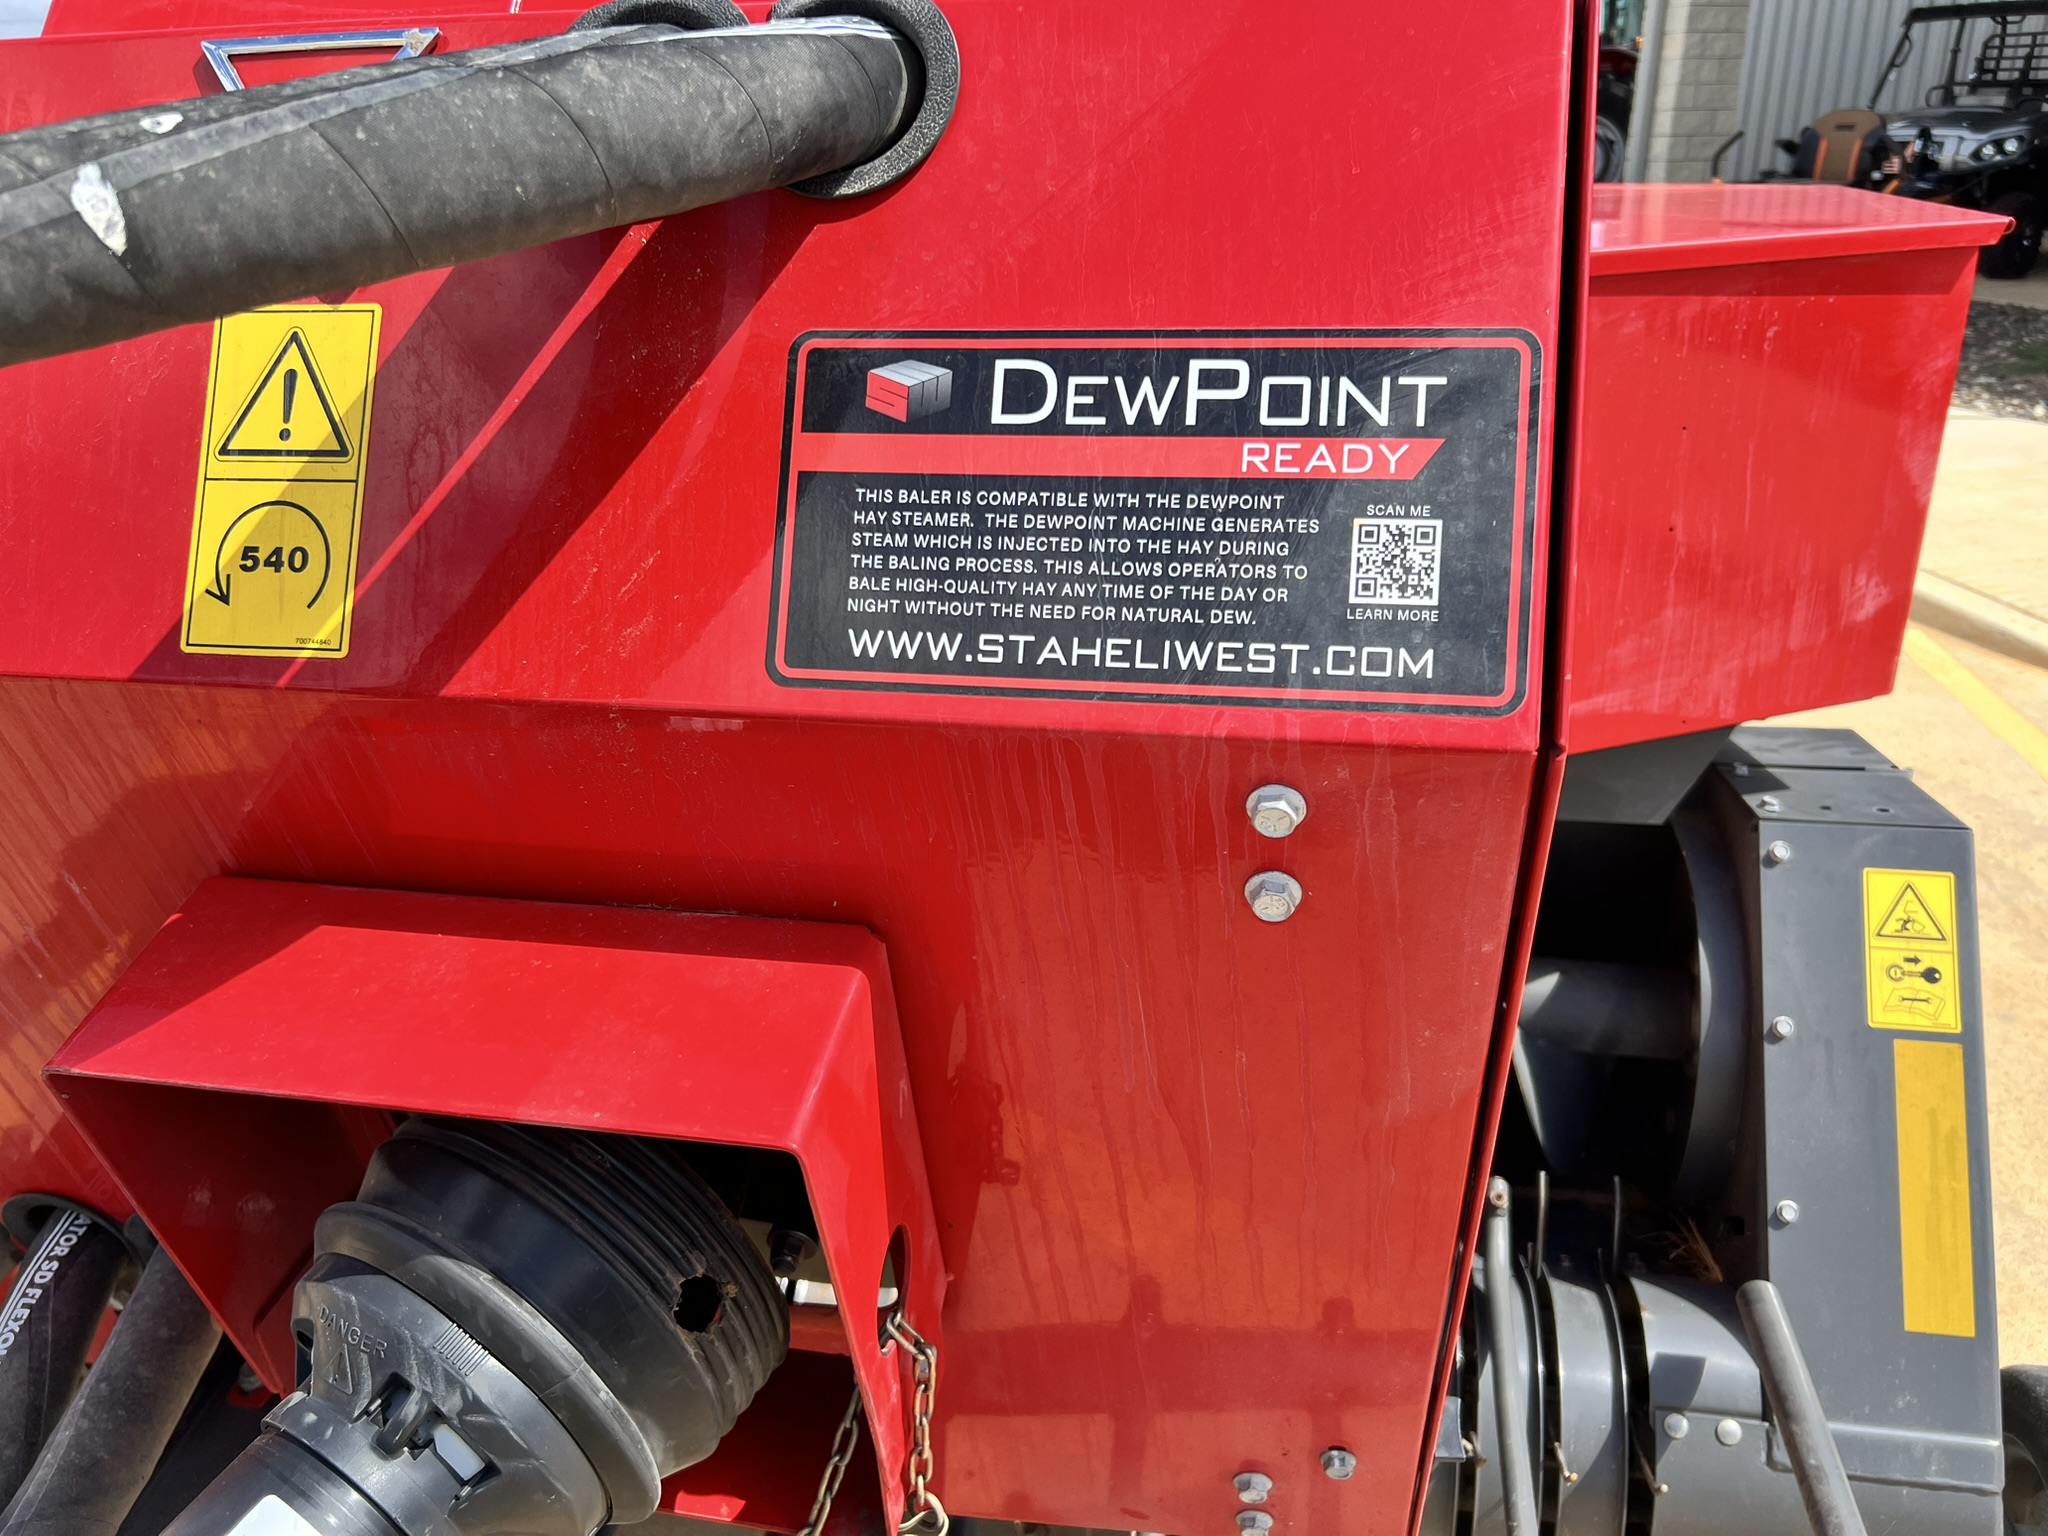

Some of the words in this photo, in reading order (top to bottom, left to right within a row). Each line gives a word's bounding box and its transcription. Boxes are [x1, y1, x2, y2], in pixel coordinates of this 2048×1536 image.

[1241, 442, 1410, 474] READY
[855, 488, 893, 503] THIS
[898, 489, 952, 505] BALER
[956, 490, 972, 505] IS
[976, 490, 1088, 507] COMPATIBLE
[1093, 493, 1140, 508] WITH
[1145, 493, 1181, 509] THE
[1186, 494, 1285, 510] DEWPOINT
[1366, 504, 1405, 517] SCAN
[1409, 504, 1431, 517] ME
[853, 510, 888, 525] HAY
[891, 511, 974, 527] STEAMER.
[984, 513, 1018, 529] THE
[1023, 514, 1118, 530] DEWPOINT
[1122, 516, 1206, 532] MACHINE
[1211, 517, 1320, 534] GENERATES
[851, 532, 908, 548] STEAM
[913, 534, 972, 550] WHICH
[977, 535, 992, 550] IS
[998, 536, 1083, 552] INJECTED
[1088, 538, 1131, 553] INTO
[1136, 538, 1172, 554] THE
[1177, 539, 1214, 555] HAY
[1219, 540, 1289, 557] DURING
[239, 546, 309, 573] 540
[850, 554, 884, 569] THE
[888, 555, 950, 571] BALING
[955, 557, 1038, 574] PROCESS.
[1043, 559, 1083, 575] THIS
[1088, 560, 1163, 577] ALLOWS
[1168, 562, 1277, 579] OPERATORS
[1282, 564, 1308, 580] TO
[849, 576, 891, 591] BALE
[896, 577, 1018, 595] HIGH-QUALITY
[1022, 581, 1057, 596] HAY
[1061, 582, 1097, 597] ANY
[1101, 583, 1145, 599] TIME
[1149, 585, 1175, 600] OF
[1179, 585, 1215, 601] THE
[1221, 586, 1258, 602] DAY
[1262, 587, 1289, 603] OR
[847, 597, 901, 614] NIGHT
[904, 600, 986, 617] WITHOUT
[990, 602, 1024, 618] THE
[1029, 604, 1076, 620] NEED
[1081, 605, 1116, 621] FOR
[1121, 606, 1204, 624] NATURAL
[1210, 609, 1256, 625] DEW.
[1346, 608, 1393, 621] LEARN
[1397, 609, 1439, 622] MORE
[848, 628, 1434, 679] WWW.STAHELIWEST.COM
[34, 1259, 60, 1284] SD
[0, 1288, 43, 1358] FLEXO
[320, 1303, 388, 1359] DANGER
